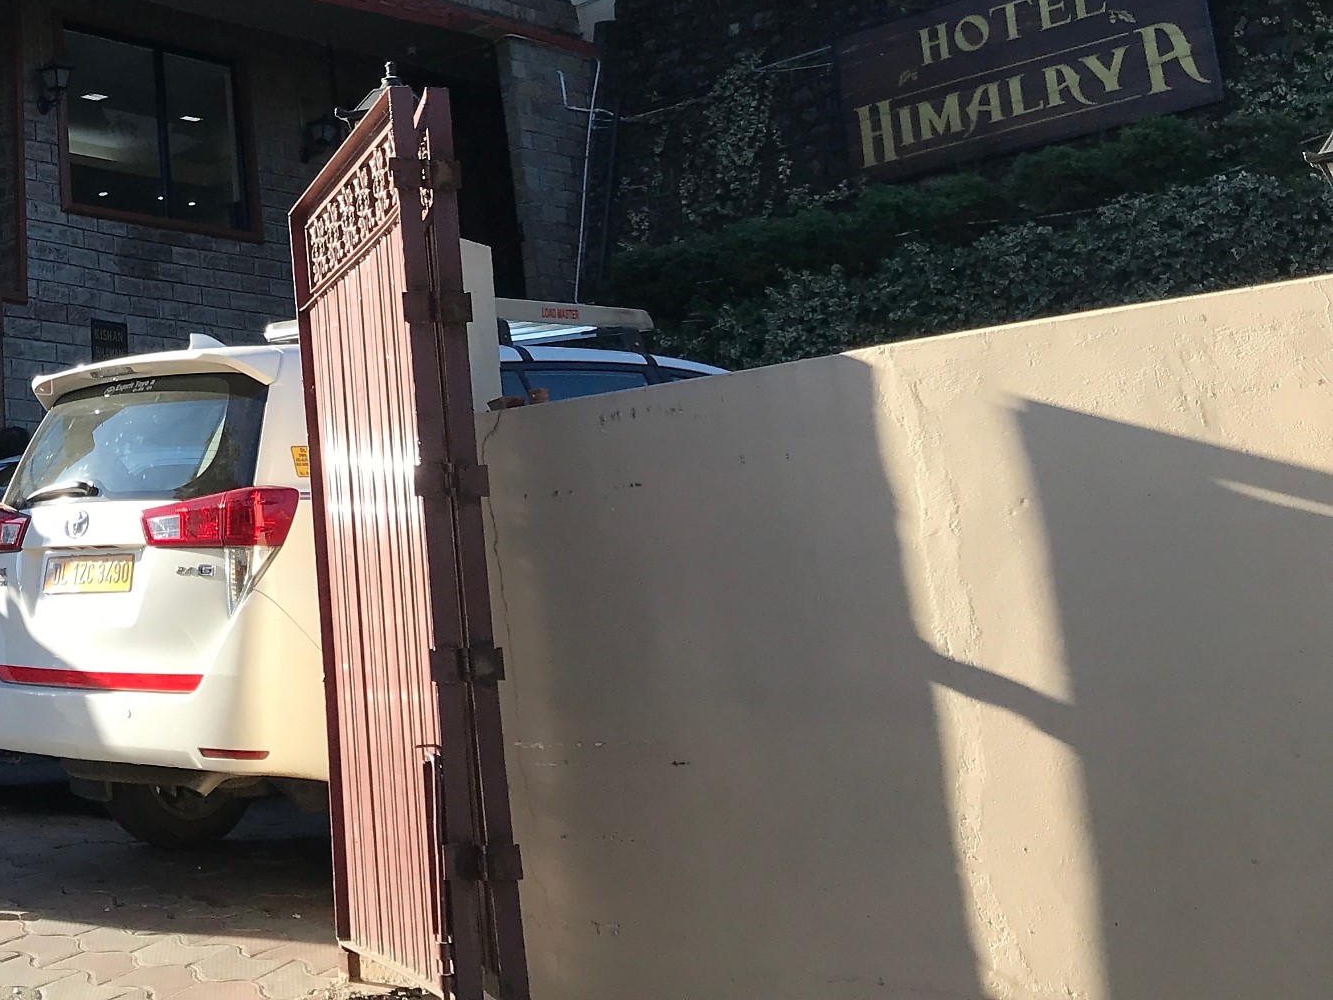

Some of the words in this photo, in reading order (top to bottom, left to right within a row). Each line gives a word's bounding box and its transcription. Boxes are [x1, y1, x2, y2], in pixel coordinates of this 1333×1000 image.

[854, 22, 1212, 168] HIMALAYA
[94, 329, 123, 342] KISHAN
[53, 563, 68, 585] DL
[98, 561, 130, 584] 3490
